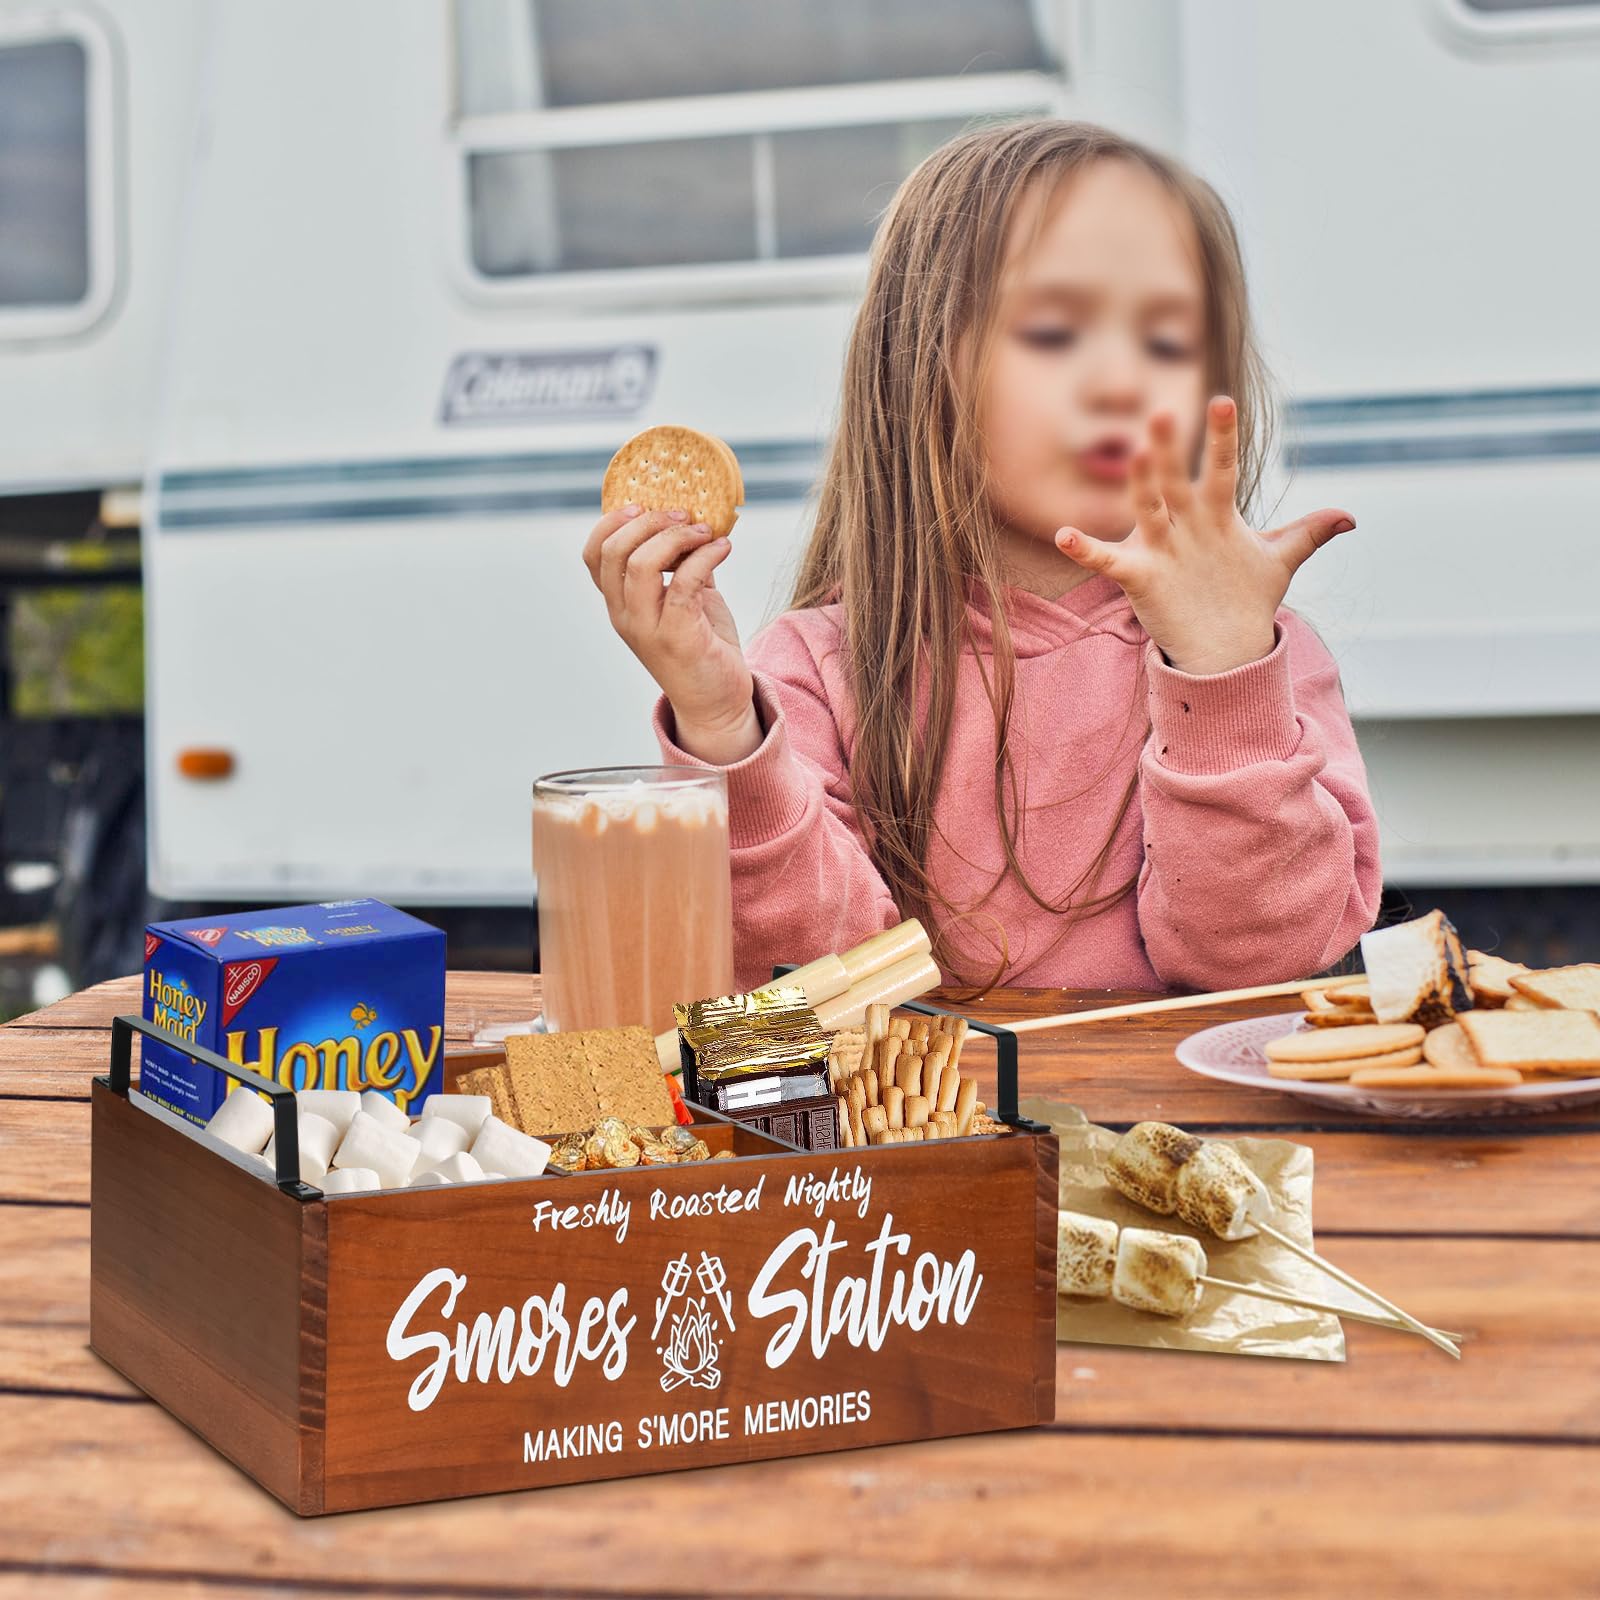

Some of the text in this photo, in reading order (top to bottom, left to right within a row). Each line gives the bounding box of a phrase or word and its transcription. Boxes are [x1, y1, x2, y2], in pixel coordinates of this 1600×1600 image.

[149, 968, 207, 1023] Honey
[229, 967, 259, 1003] NABISCO
[153, 1004, 198, 1044] Maid
[226, 1025, 442, 1101] Honey
[533, 1165, 872, 1244] Freshly Roasted Nightly
[387, 1214, 983, 1411] Smores Station
[523, 1390, 871, 1463] MAKING S'MORE MEMORIES
